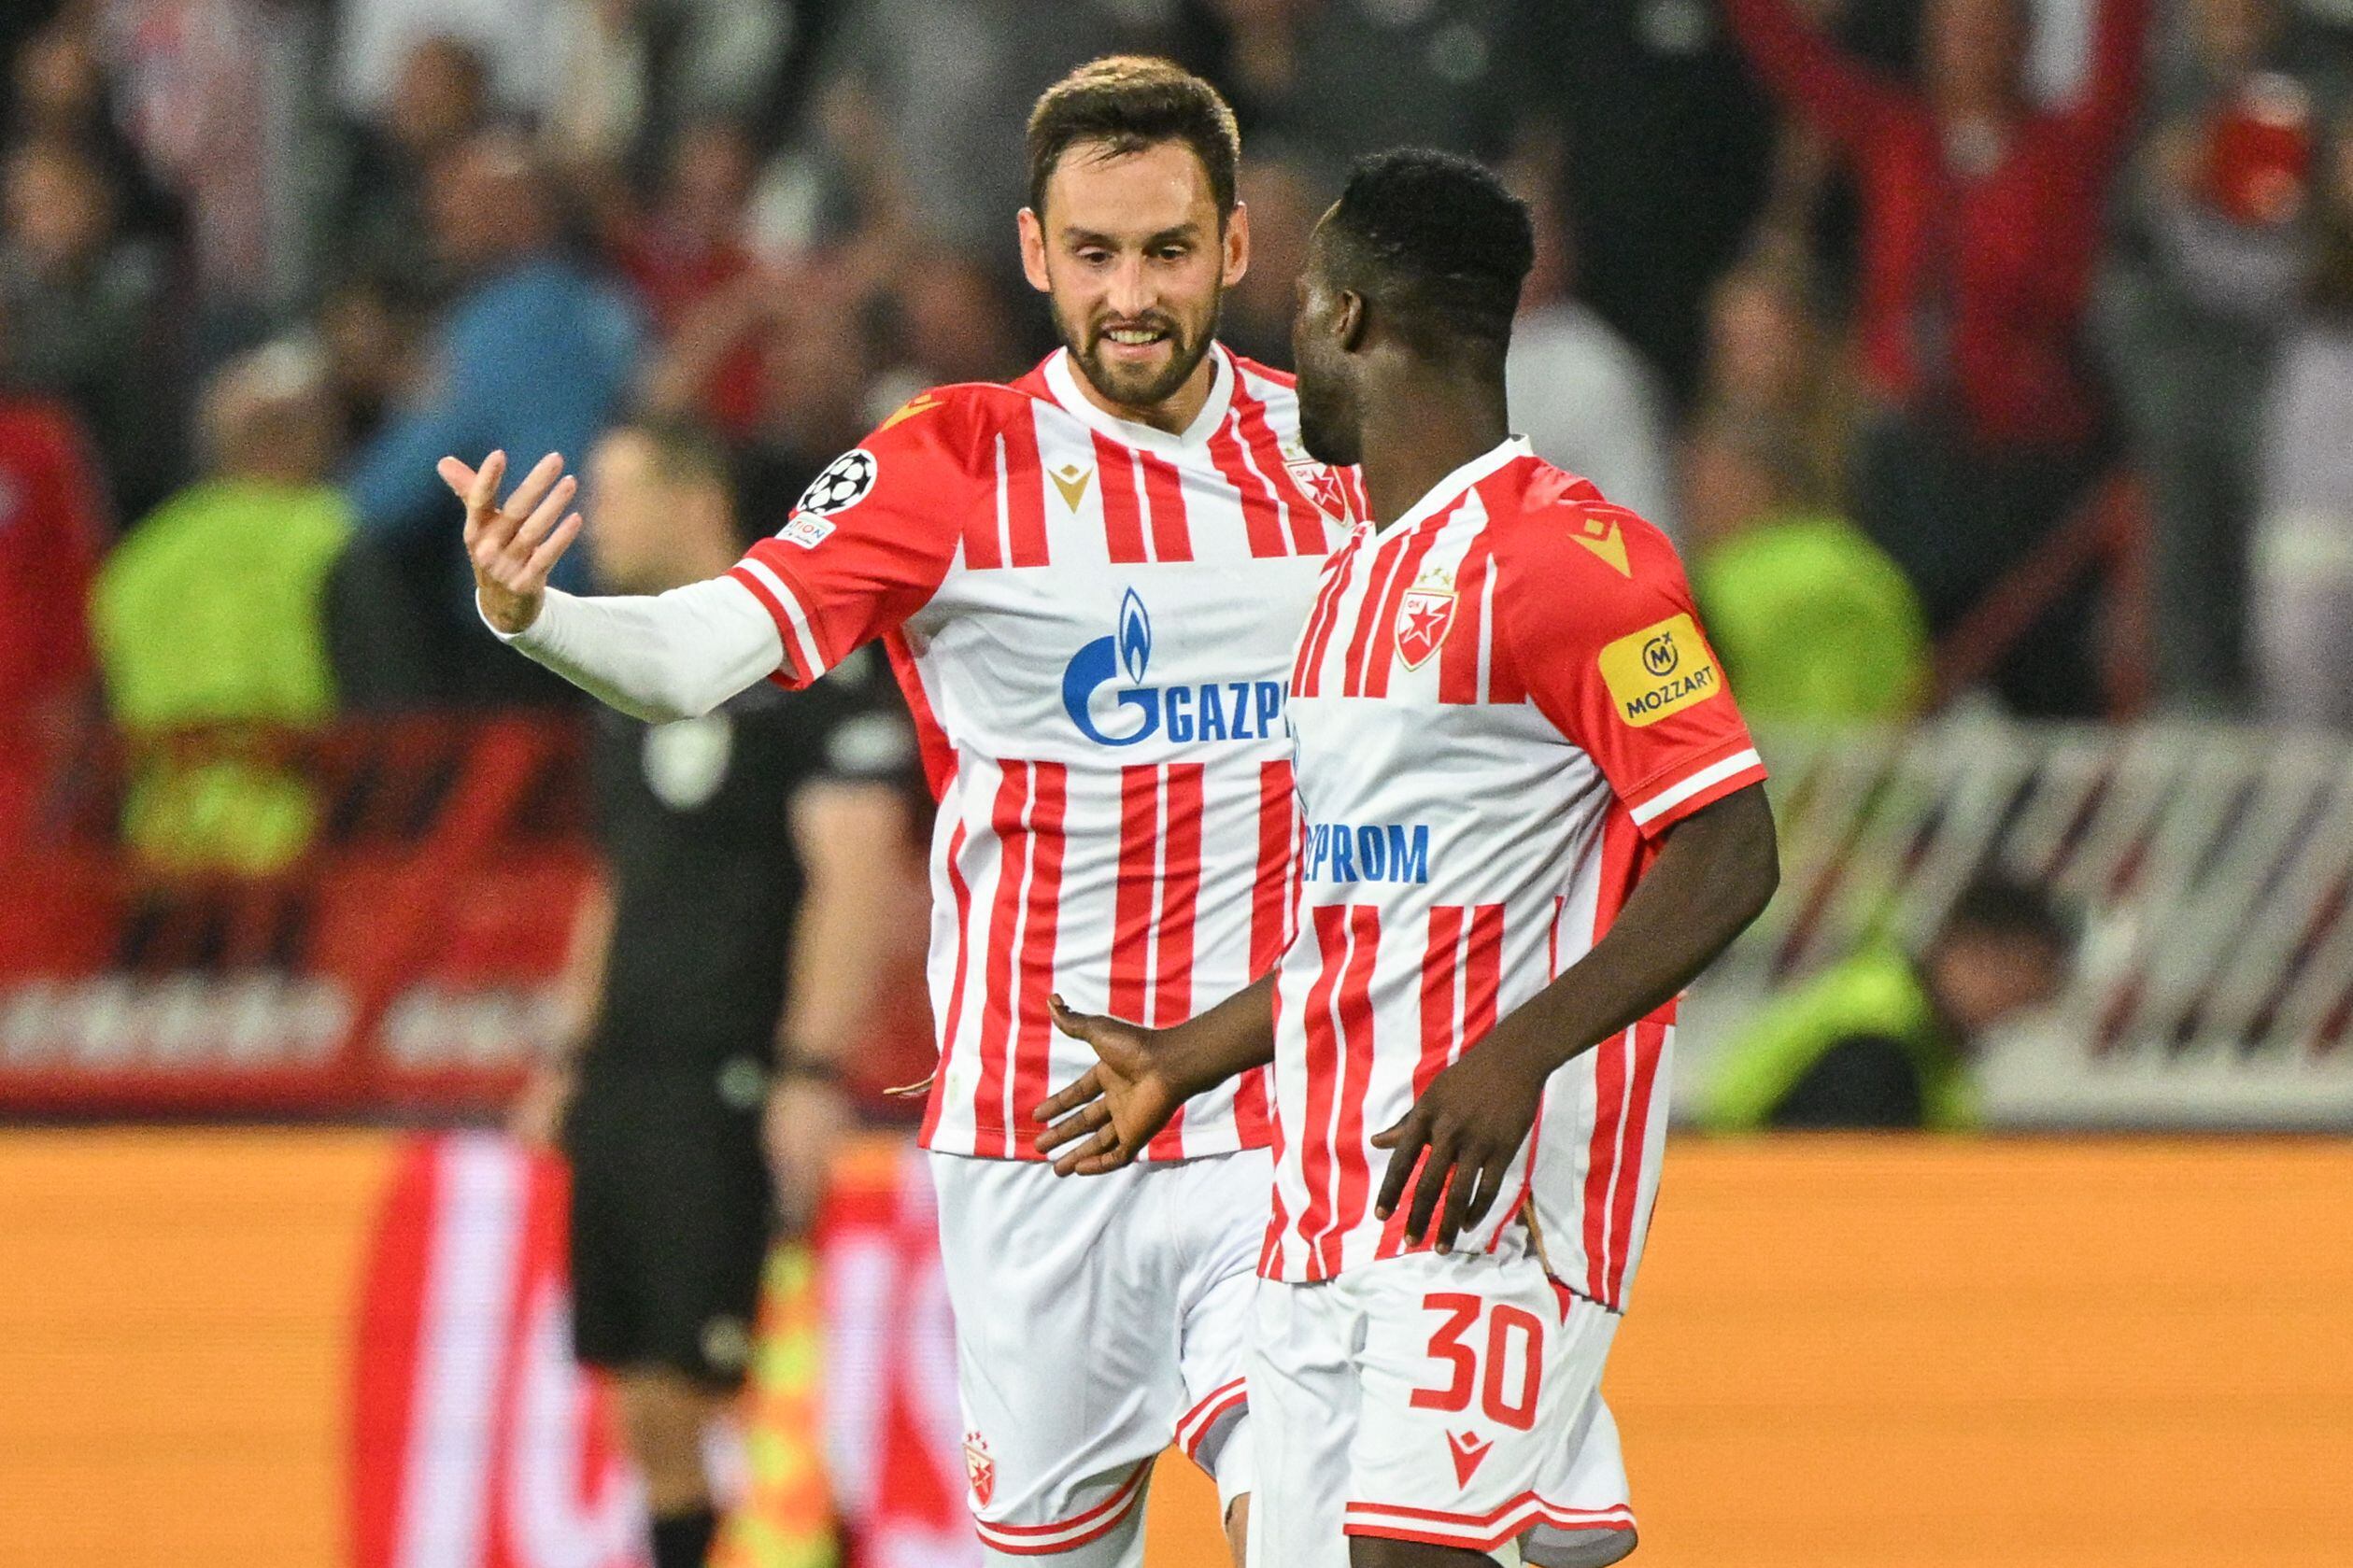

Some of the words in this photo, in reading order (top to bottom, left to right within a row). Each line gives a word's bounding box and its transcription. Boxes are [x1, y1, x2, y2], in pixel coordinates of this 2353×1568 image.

[1165, 681, 1291, 743] GAZP
[1626, 666, 1714, 718] MOZZART
[1410, 1293, 1544, 1432] 30
